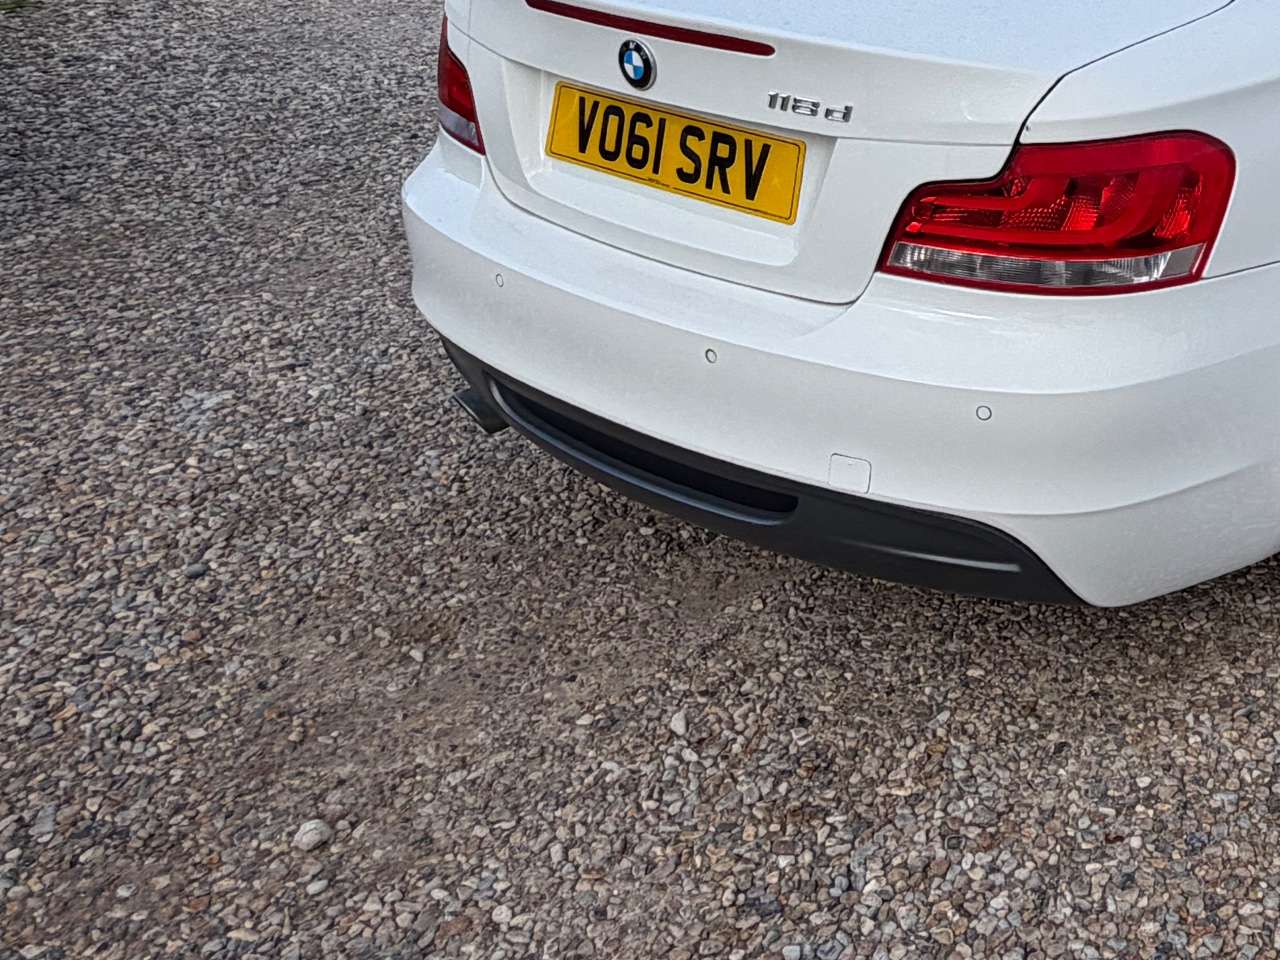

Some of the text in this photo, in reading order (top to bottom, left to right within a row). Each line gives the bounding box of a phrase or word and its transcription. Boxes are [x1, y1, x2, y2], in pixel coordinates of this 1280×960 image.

[767, 90, 853, 123] 118d
[578, 95, 772, 201] VO61 SRV
